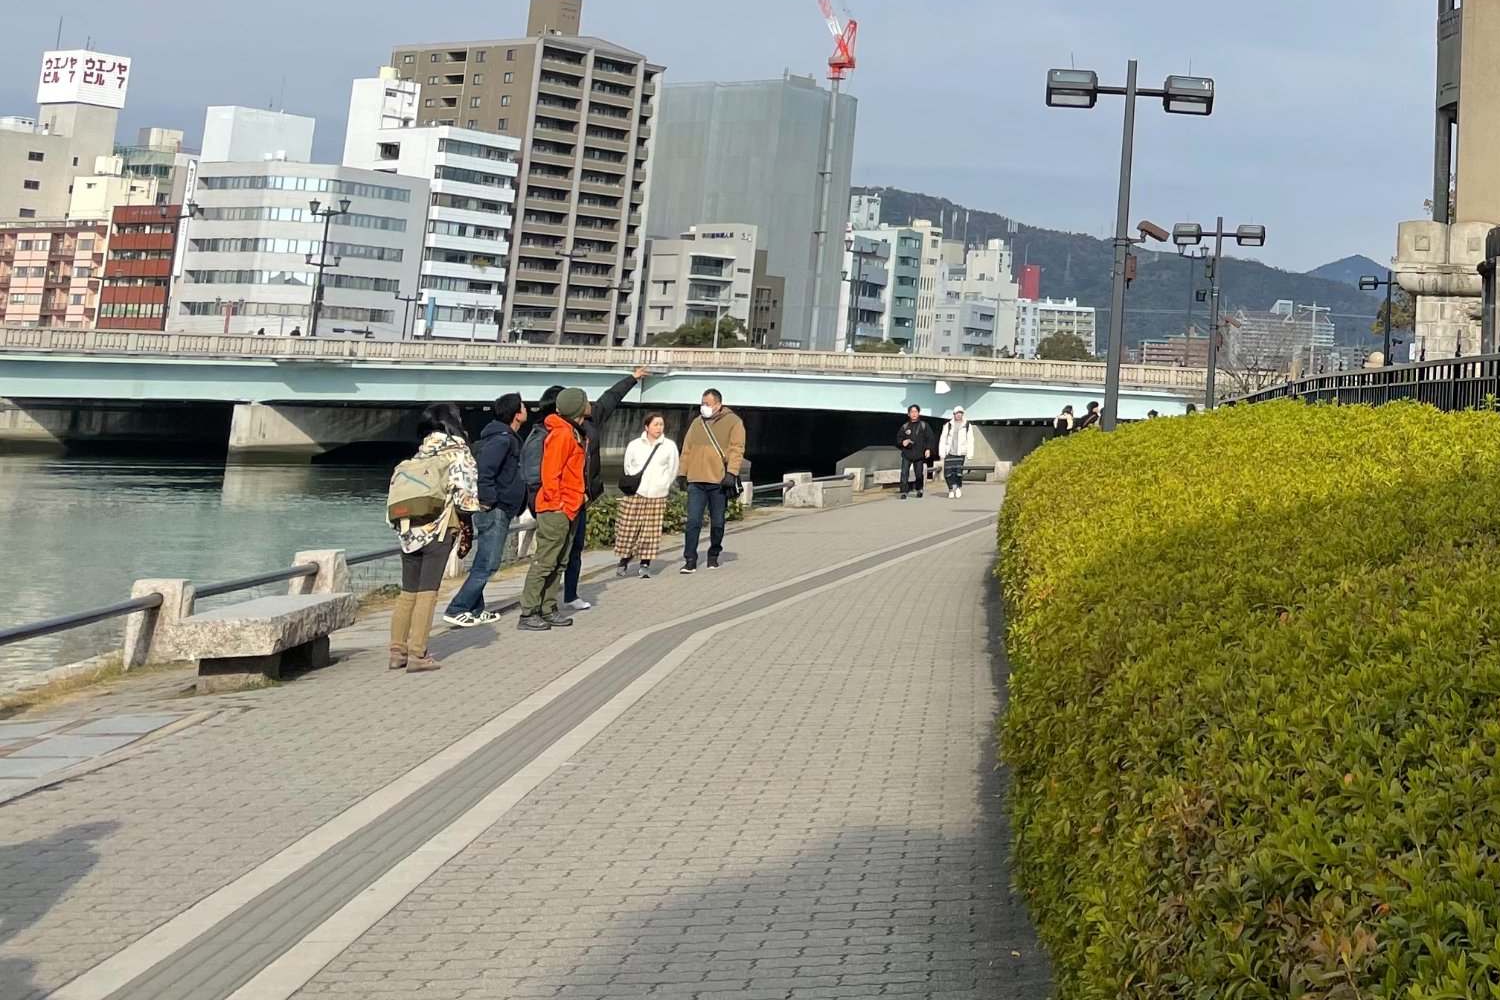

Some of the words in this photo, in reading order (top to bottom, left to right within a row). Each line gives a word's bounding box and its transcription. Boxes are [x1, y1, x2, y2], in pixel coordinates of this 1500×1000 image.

[45, 57, 77, 69] ウエノヤ
[85, 58, 127, 74] ウエノヤ
[43, 71, 60, 83] ビル
[68, 71, 76, 83] 7
[83, 71, 105, 86] ビル
[116, 77, 126, 89] 7
